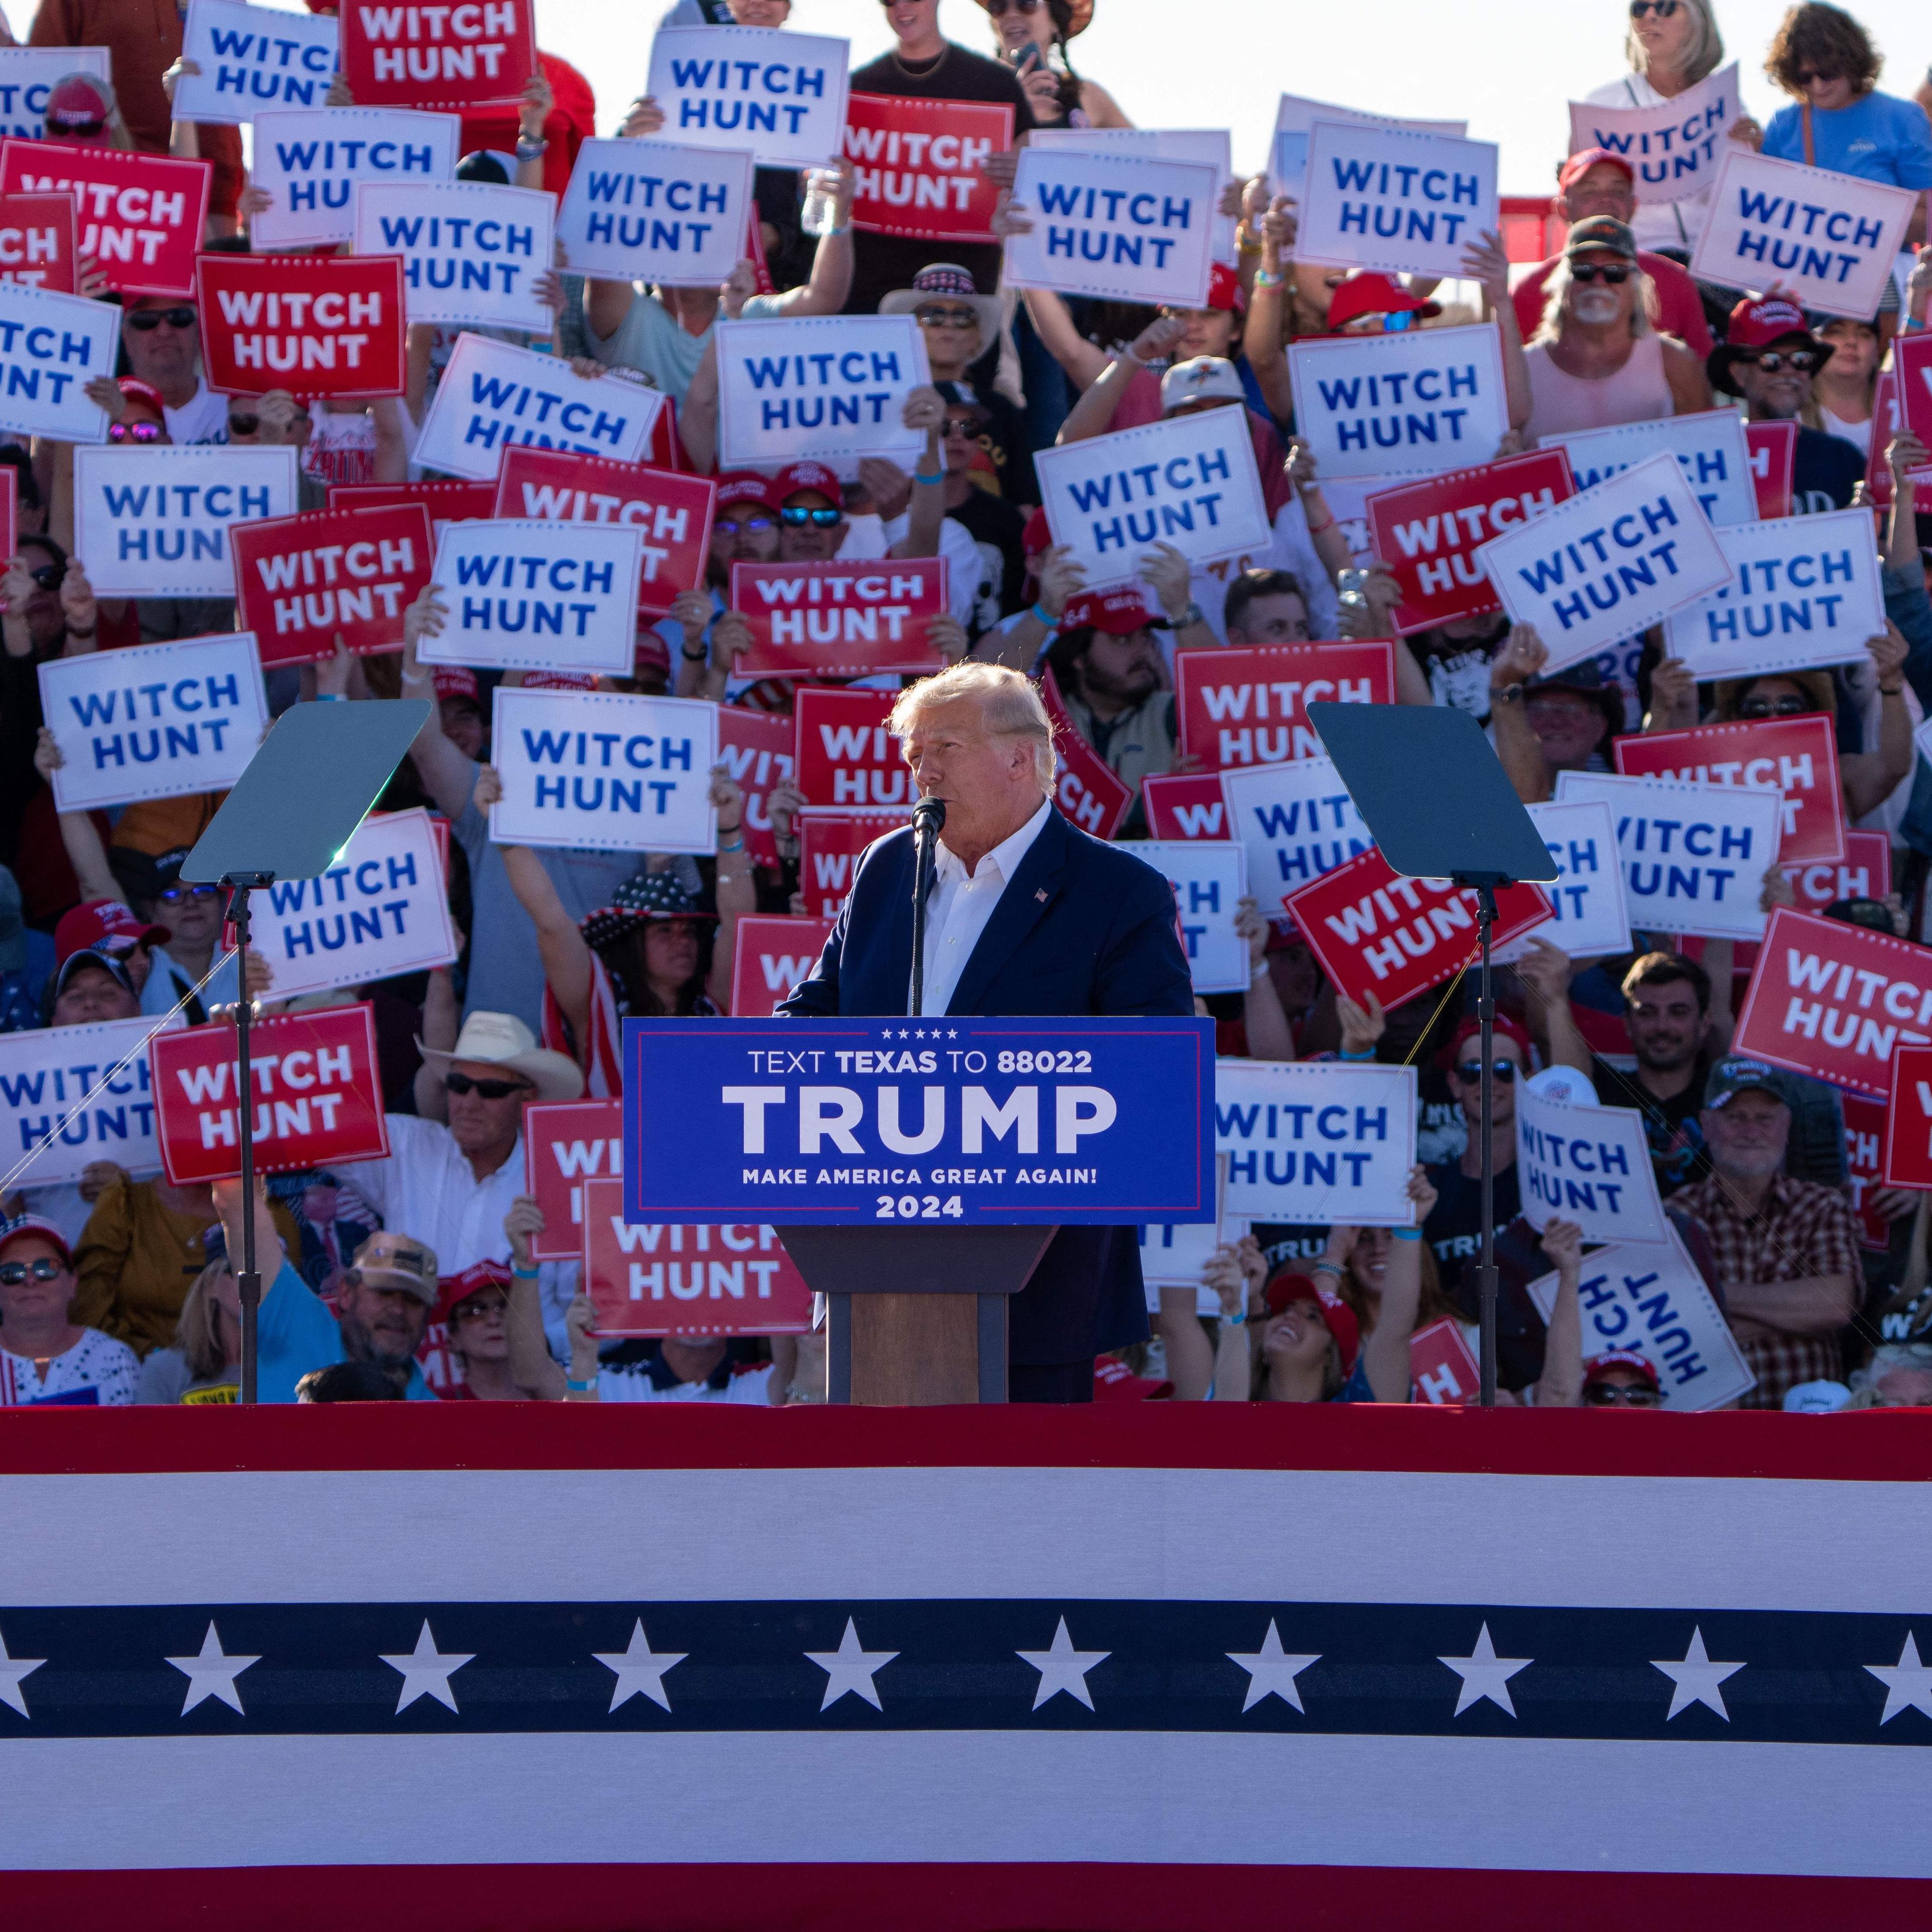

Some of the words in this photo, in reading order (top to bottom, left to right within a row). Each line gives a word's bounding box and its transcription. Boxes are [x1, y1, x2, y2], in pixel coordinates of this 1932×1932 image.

[359, 2, 516, 40] WITCH
[211, 28, 339, 71] WITC
[374, 43, 506, 82] HUNT
[216, 65, 331, 105] HUN
[671, 58, 825, 97] WITCH
[679, 98, 810, 134] HUNT
[1594, 96, 1725, 154] WITCH
[277, 140, 432, 173] WITCH
[844, 124, 991, 170] WITCH
[1631, 133, 1717, 183] UNT
[289, 178, 350, 211] HU
[588, 171, 727, 214] WITCH
[855, 167, 978, 211] HUNT
[1332, 156, 1480, 206] WITCH
[1038, 182, 1191, 229] WITCH
[1338, 202, 1466, 245] HUNT
[1738, 186, 1884, 249] WITCH
[78, 224, 167, 265] UNT
[380, 216, 532, 256] WITCH
[586, 211, 711, 252] HUNT
[1047, 225, 1175, 269] HUNT
[405, 258, 521, 294] HUNT
[1736, 228, 1861, 283] HUNT
[217, 291, 381, 328] WITCH
[0, 319, 91, 366] TCH
[233, 333, 369, 370] HUNT
[0, 363, 73, 404] NT
[744, 351, 901, 389] WITCH
[1317, 364, 1479, 411] WITCH
[471, 372, 626, 445] WITCH
[761, 392, 892, 431] HUNT
[1336, 408, 1468, 452] HUNT
[102, 484, 269, 518] WITCH
[1068, 448, 1231, 513] WITCH
[522, 481, 689, 542] WITCH
[1092, 492, 1225, 553] HUNT
[1393, 487, 1556, 558] WITCH
[118, 528, 222, 561] HUN
[256, 537, 415, 592] WITCH
[1519, 495, 1677, 595] WITCH
[457, 555, 614, 594] WITCH
[754, 574, 924, 604] WITCH
[1415, 546, 1487, 596] HU
[1551, 541, 1678, 630] HUNT
[1717, 549, 1854, 598] ITCH
[274, 582, 406, 634] HUNT
[462, 596, 596, 636] HUNT
[771, 606, 911, 645] HUNT
[1707, 594, 1843, 643] HUNT
[69, 673, 239, 728] WITCH
[92, 718, 229, 770] HUNT
[522, 728, 691, 771] WITCH
[1219, 726, 1327, 764] HUN
[535, 774, 676, 815] HUNT
[833, 768, 918, 804] HU
[1254, 793, 1361, 838] WIT
[1618, 816, 1753, 859] ITCH
[270, 852, 417, 916] WITCH
[1623, 861, 1735, 901] UNT
[283, 901, 409, 958] HUNT
[1324, 876, 1454, 945] WIT
[748, 1051, 825, 1073] TEXT
[835, 1051, 937, 1074] TEXAS
[947, 1051, 987, 1073] TO
[997, 1051, 1092, 1073] 88022
[19, 1102, 153, 1151] HUNT
[199, 1093, 342, 1150] HUNT
[722, 1086, 1117, 1155] TRUMP
[1216, 1103, 1387, 1141] WITCH
[1229, 1150, 1373, 1186] HUNT
[1521, 1120, 1630, 1175] WITCH
[743, 1169, 808, 1184] MAKE
[816, 1169, 922, 1184] AMERICA
[931, 1169, 1006, 1184] GREAT
[1015, 1169, 1096, 1184] AGAIN!
[1529, 1167, 1623, 1213] HUNT
[876, 1195, 963, 1218] 2024
[1263, 1237, 1325, 1267] TRU
[629, 1260, 780, 1301] HUNT
[1623, 1271, 1707, 1385] HUNT
